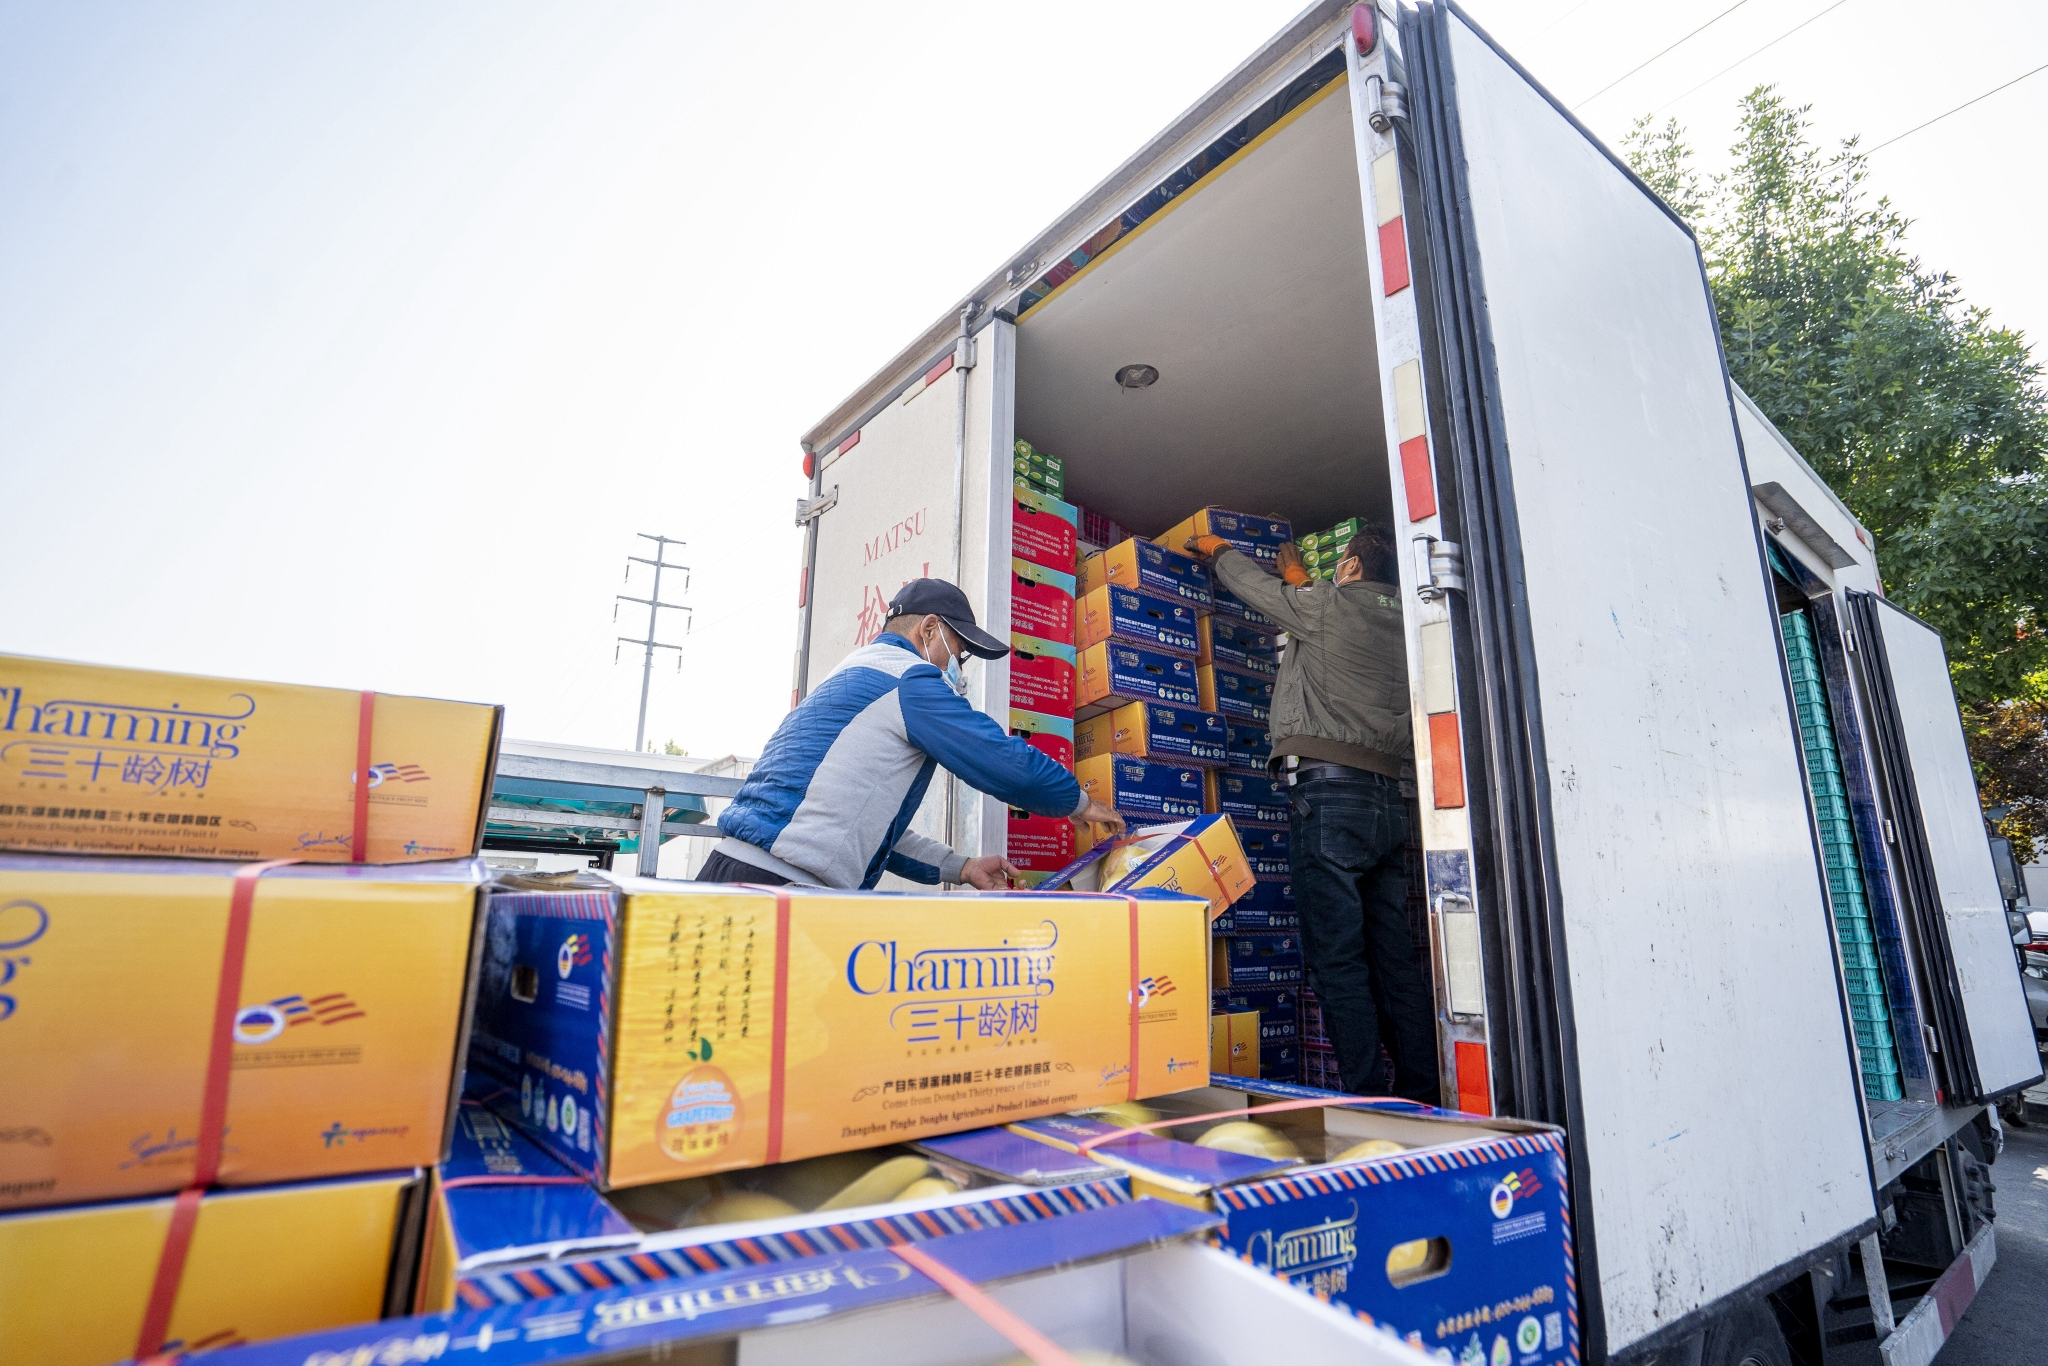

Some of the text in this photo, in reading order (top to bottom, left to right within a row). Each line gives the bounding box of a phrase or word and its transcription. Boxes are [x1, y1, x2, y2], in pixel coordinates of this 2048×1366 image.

[863, 507, 927, 567] MATSU
[854, 562, 930, 647] 松
[21, 749, 212, 790] 三十龄树
[100, 824, 135, 837] Thirty
[138, 828, 167, 838] years
[169, 828, 181, 838] of
[182, 828, 206, 838] fruit
[138, 843, 175, 853] Product
[179, 845, 216, 856] Limited
[219, 848, 260, 859] company
[847, 920, 1059, 997] Charming
[907, 998, 1040, 1042] 三十龄树
[841, 1093, 1078, 1138] Zhangzhou Pinghe Donghu Agricultural Product Limited company
[882, 1099, 909, 1111] Come
[911, 1096, 932, 1108] from
[934, 1091, 967, 1104] Donghu
[969, 1087, 992, 1100] Thirty
[992, 1086, 1015, 1098] years
[1017, 1081, 1025, 1092] of
[1026, 1080, 1042, 1091] fruit
[590, 1259, 912, 1345] Charming
